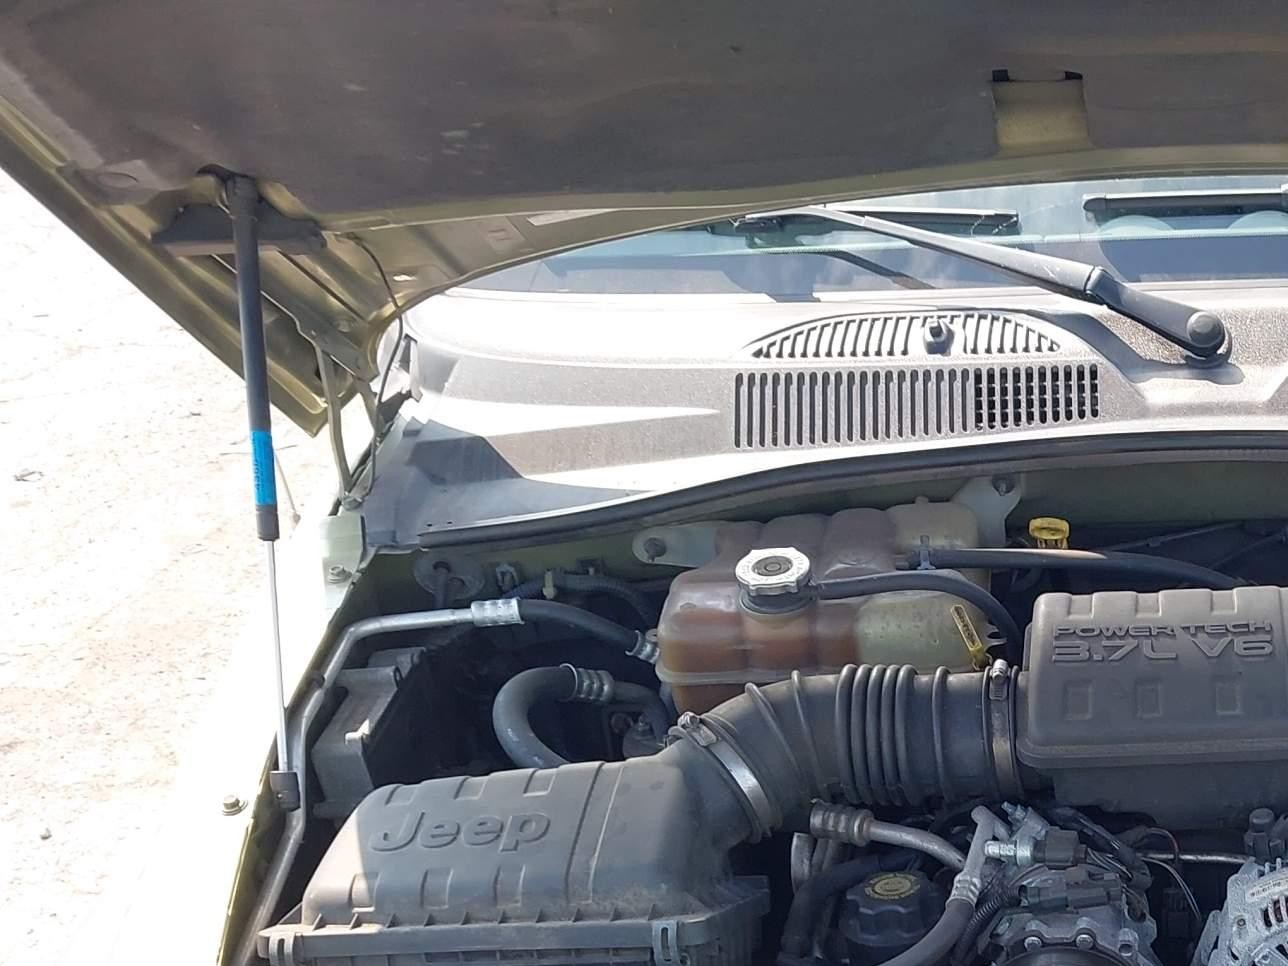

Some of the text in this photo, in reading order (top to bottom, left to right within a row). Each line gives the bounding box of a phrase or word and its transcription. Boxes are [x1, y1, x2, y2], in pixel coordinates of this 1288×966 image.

[1052, 634, 1274, 662] 3.7L V6
[367, 811, 552, 853] Jeep
